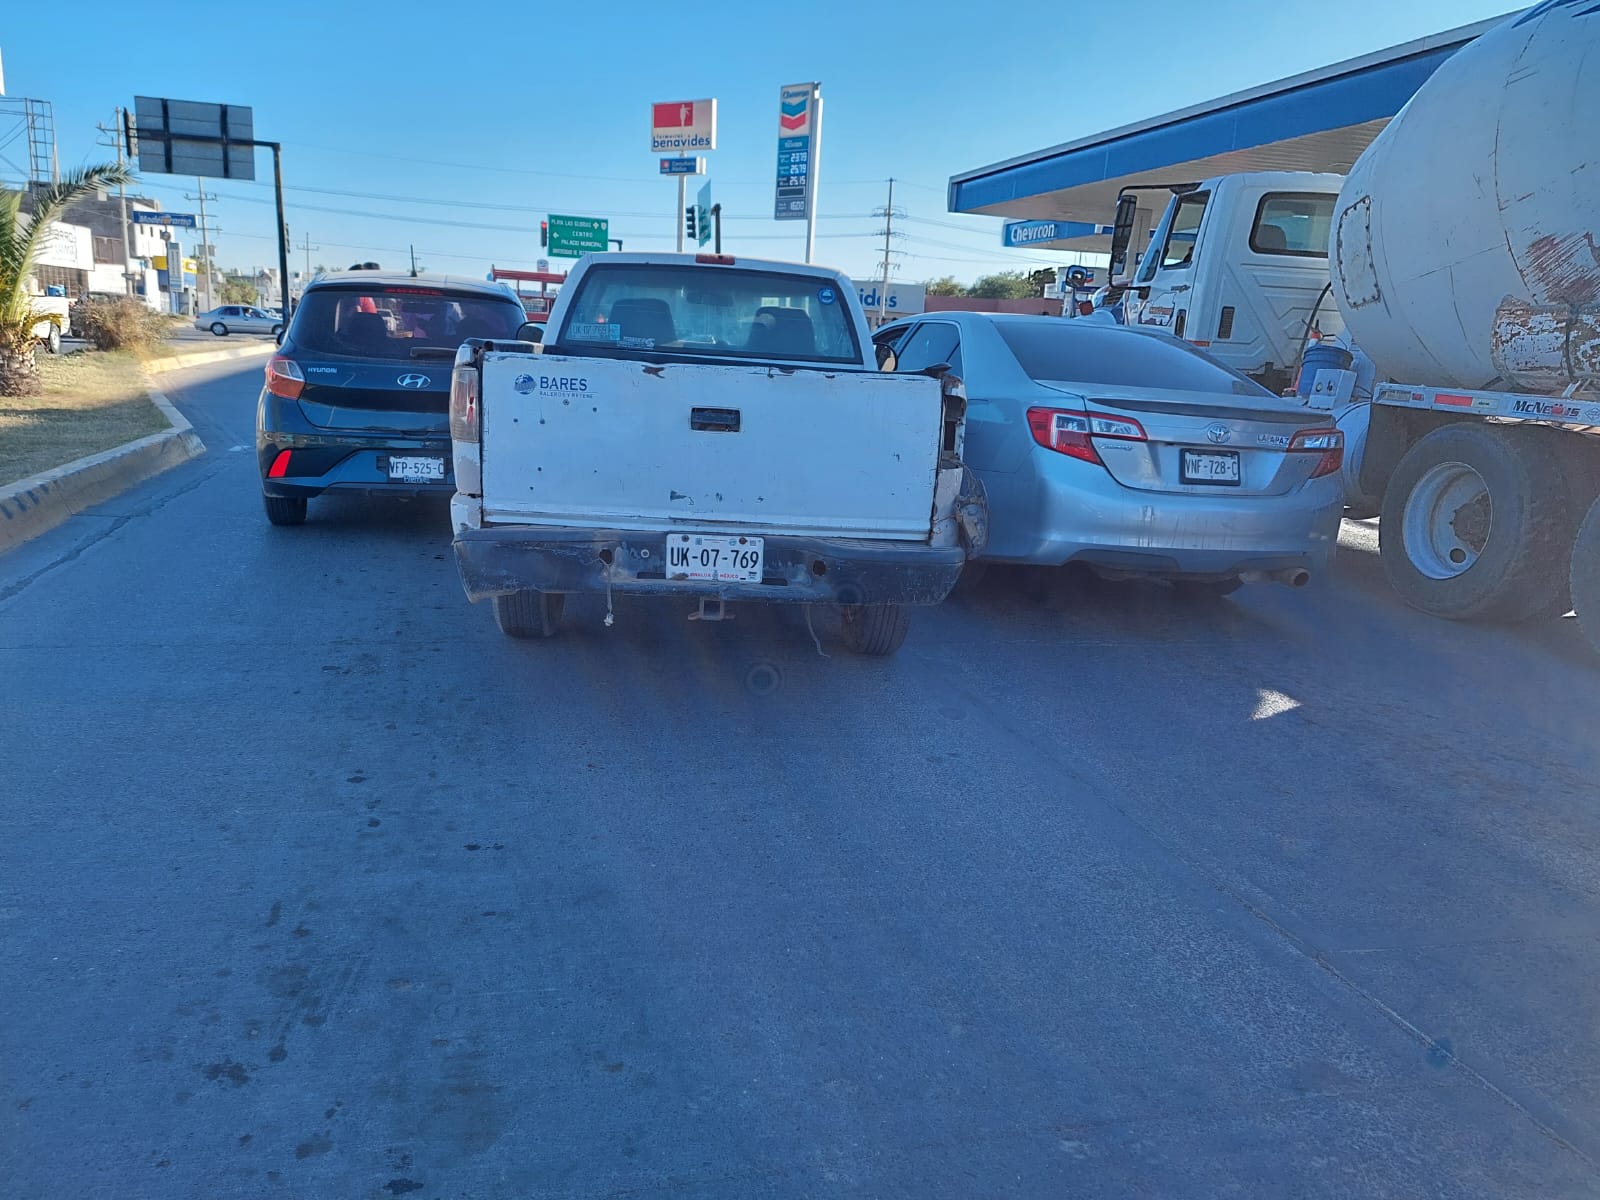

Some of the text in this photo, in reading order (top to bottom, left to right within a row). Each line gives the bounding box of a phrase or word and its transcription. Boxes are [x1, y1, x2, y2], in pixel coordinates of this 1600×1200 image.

[653, 133, 710, 148] benavides
[572, 230, 593, 238] CENTRO
[1011, 224, 1055, 243] Chevron
[540, 376, 588, 391] BARES
[389, 461, 444, 475] VFP-525-C
[1185, 458, 1238, 476] VNF-728-C
[670, 547, 760, 569] UK-07-769
